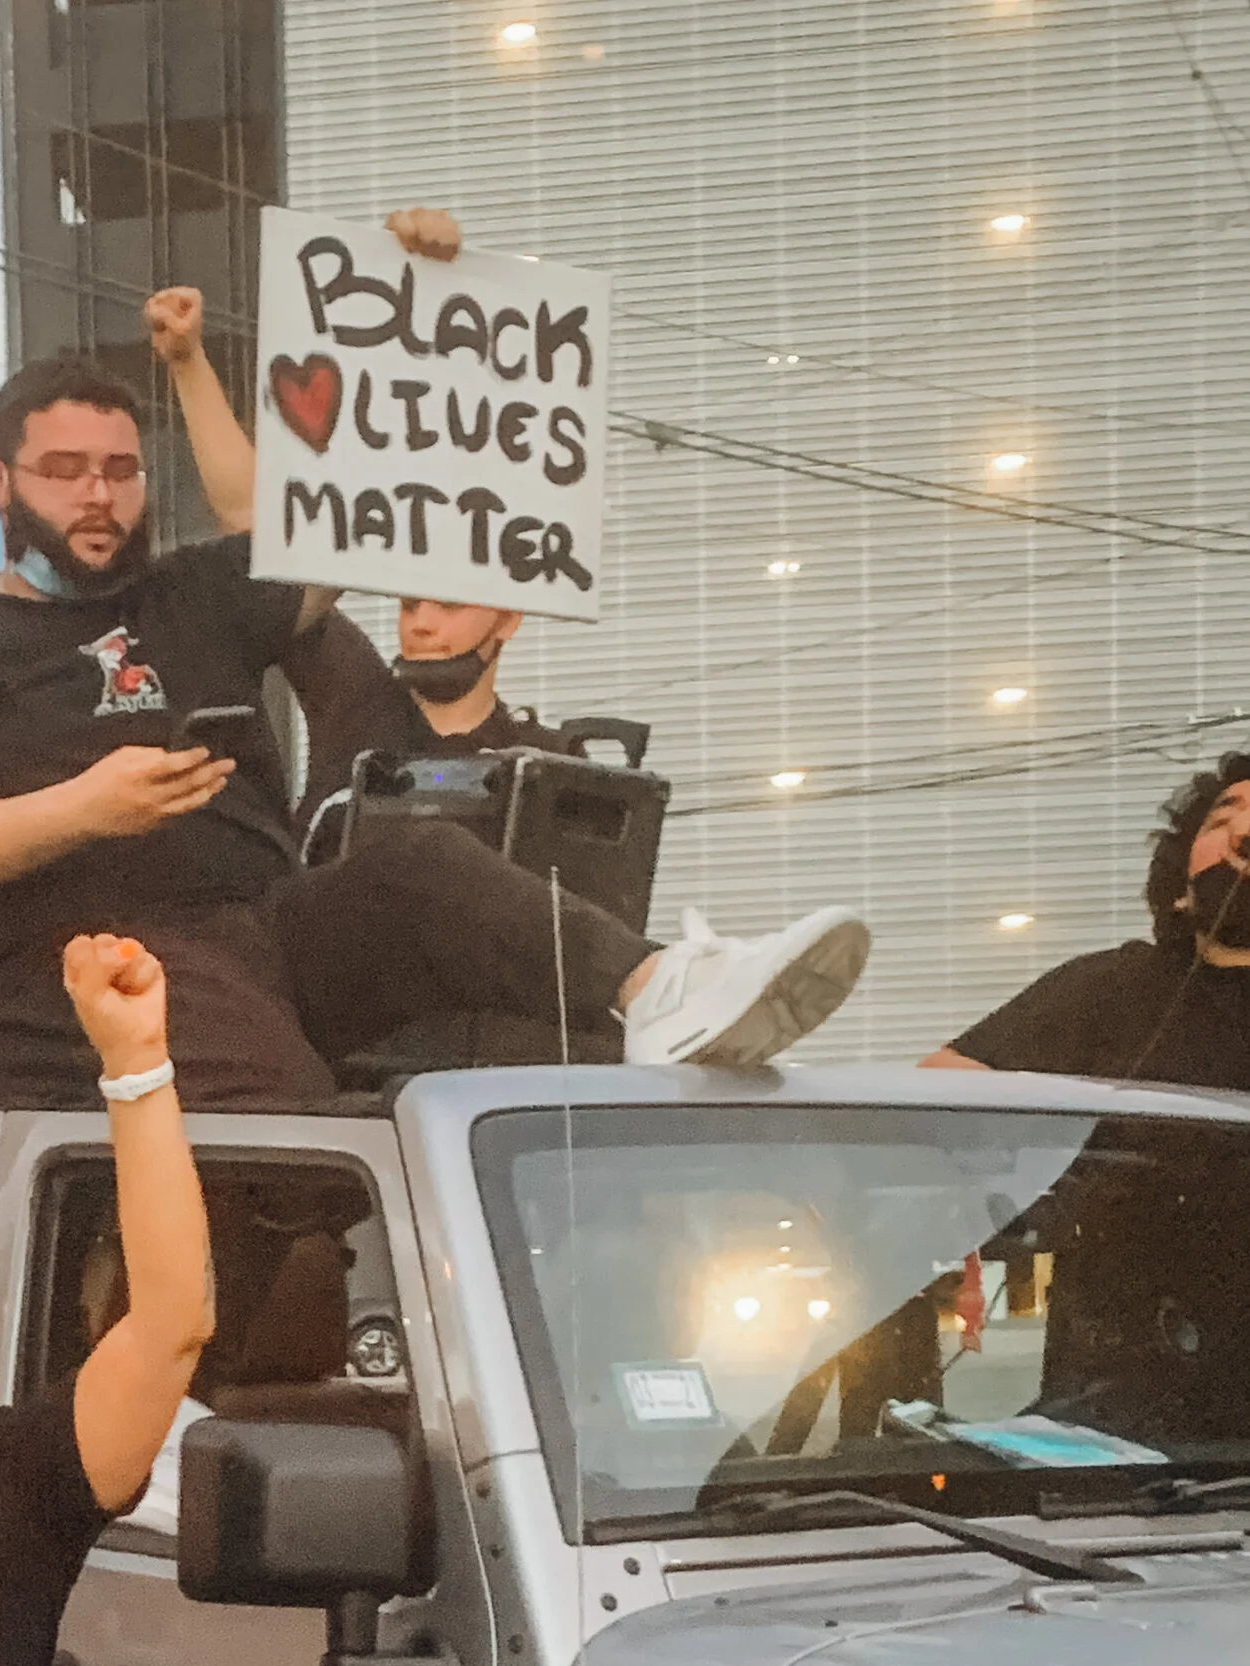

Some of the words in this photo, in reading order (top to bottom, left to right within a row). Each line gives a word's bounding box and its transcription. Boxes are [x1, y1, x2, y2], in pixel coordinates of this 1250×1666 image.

[297, 235, 593, 388] BLACK
[353, 368, 587, 486] LIVES
[284, 477, 593, 592] MATTER
